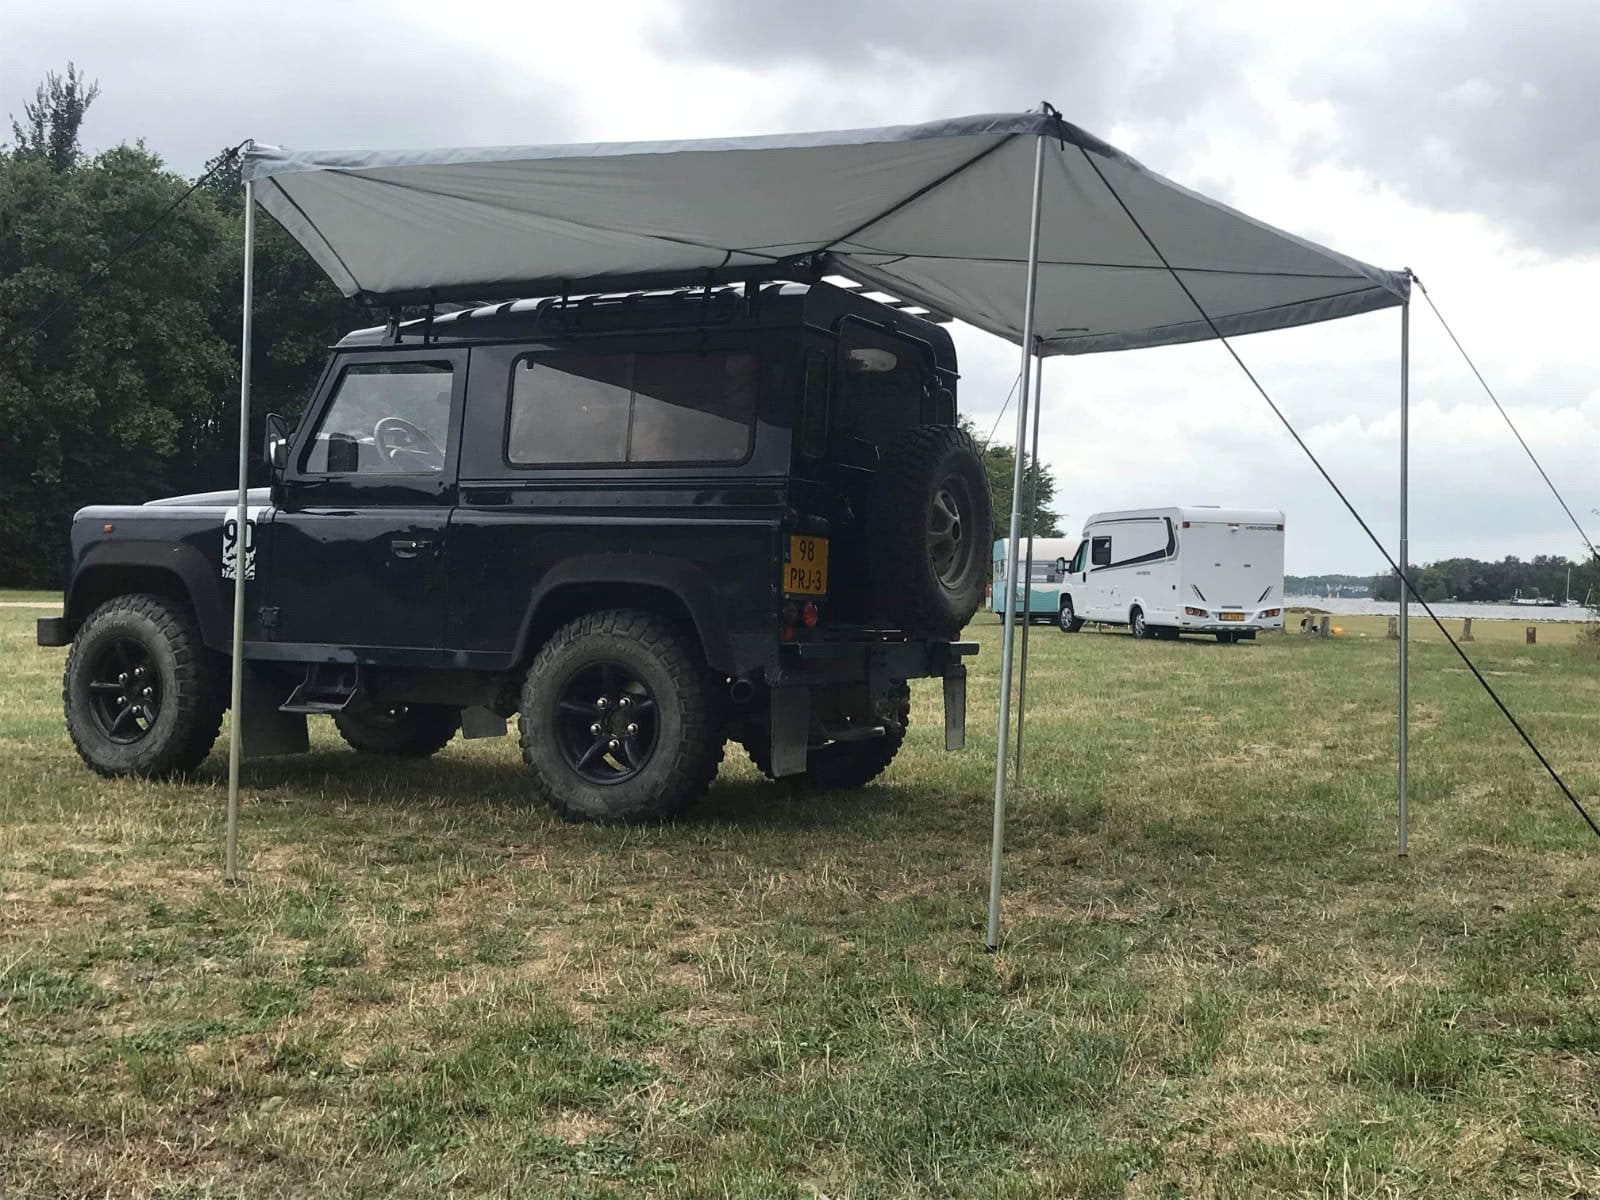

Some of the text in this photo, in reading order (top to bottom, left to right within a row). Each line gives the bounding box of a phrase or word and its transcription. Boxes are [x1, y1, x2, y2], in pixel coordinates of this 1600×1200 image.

[224, 518, 257, 553] 90
[799, 540, 815, 562] 98
[790, 567, 822, 591] PRJ-3
